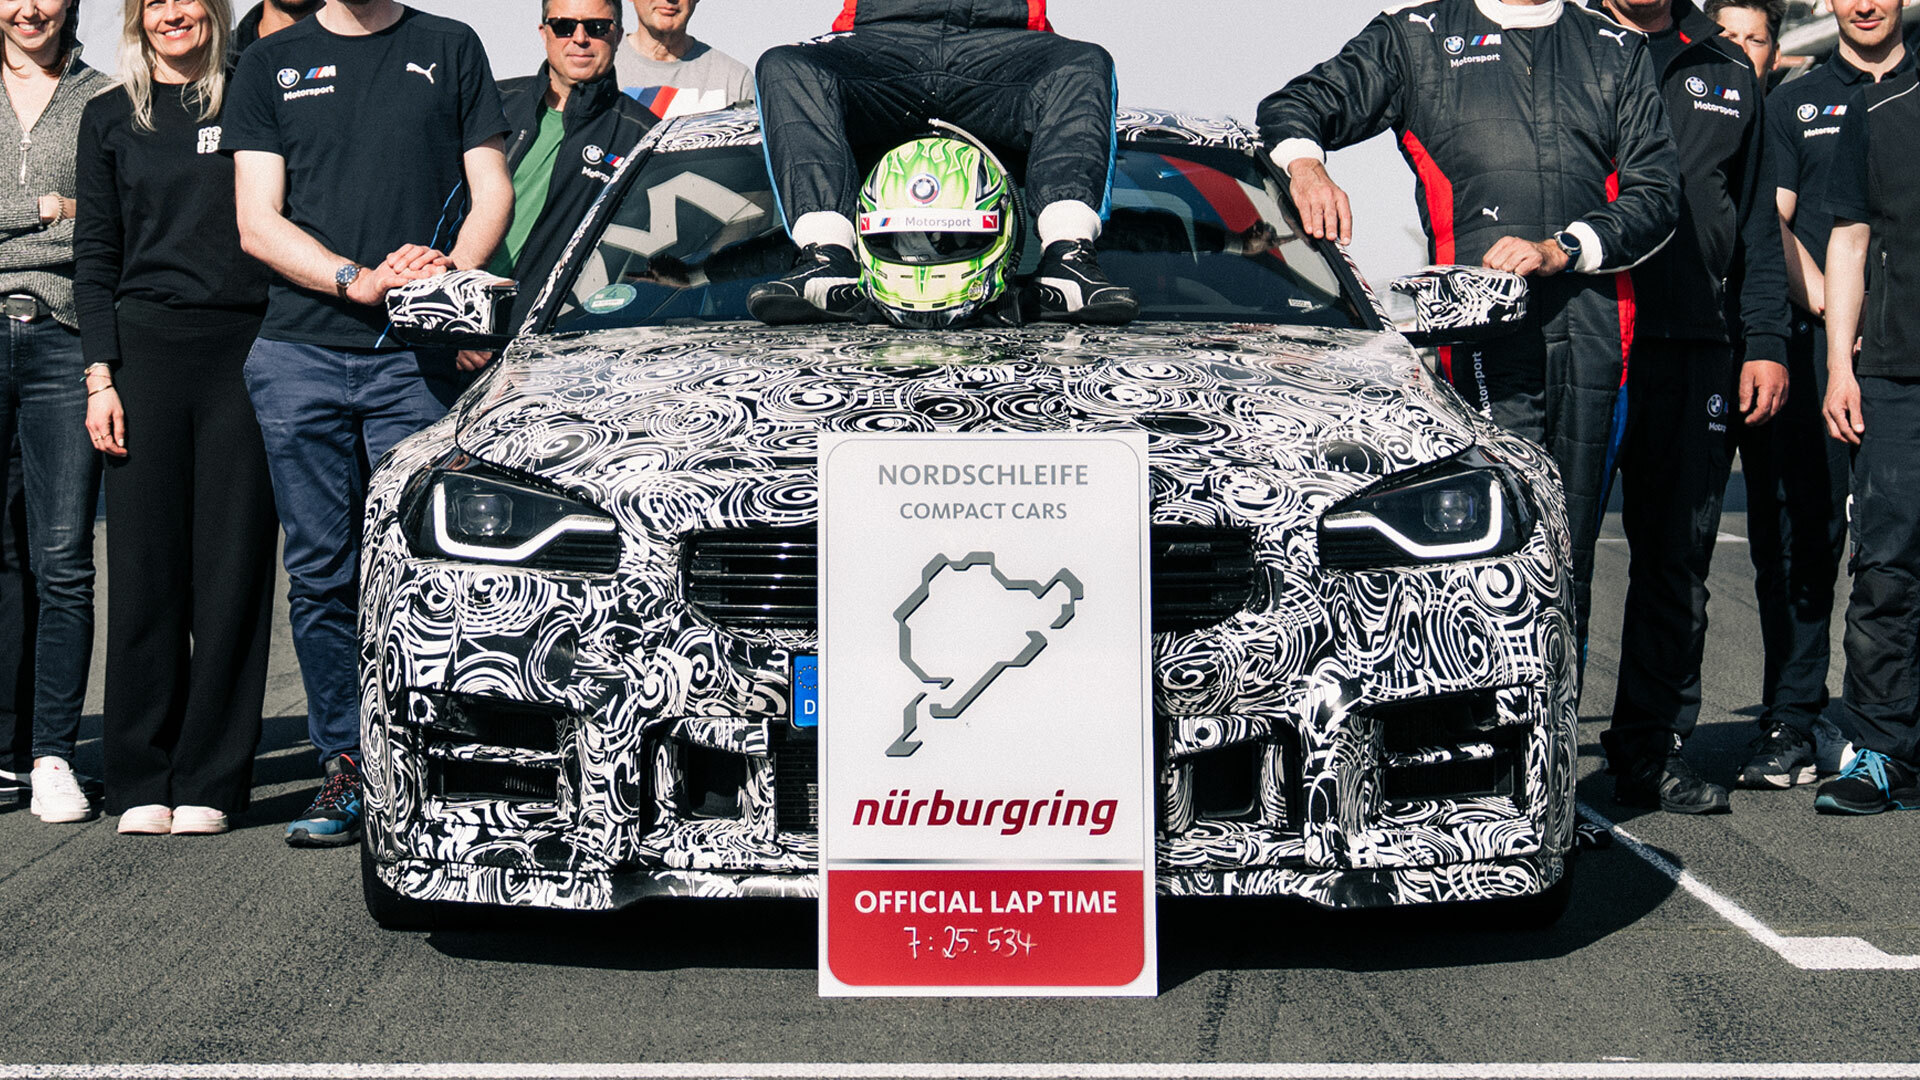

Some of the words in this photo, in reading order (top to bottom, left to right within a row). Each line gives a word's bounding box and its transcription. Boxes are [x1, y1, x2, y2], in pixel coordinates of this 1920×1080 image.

[1450, 53, 1500, 68] Motorsport
[283, 85, 335, 101] Motorsport
[1693, 100, 1740, 118] Motorsport
[905, 217, 971, 229] Motorsport
[1472, 351, 1493, 420] Motorsport
[878, 464, 1088, 485] NORDSCHLEIFE
[899, 503, 1006, 519] COMPACT
[1011, 503, 1067, 519] CARS
[804, 700, 816, 714] D
[852, 789, 1118, 835] nürburgring
[854, 890, 983, 914] OFFICIAL
[990, 890, 1043, 913] LAP
[1048, 890, 1117, 913] TIME
